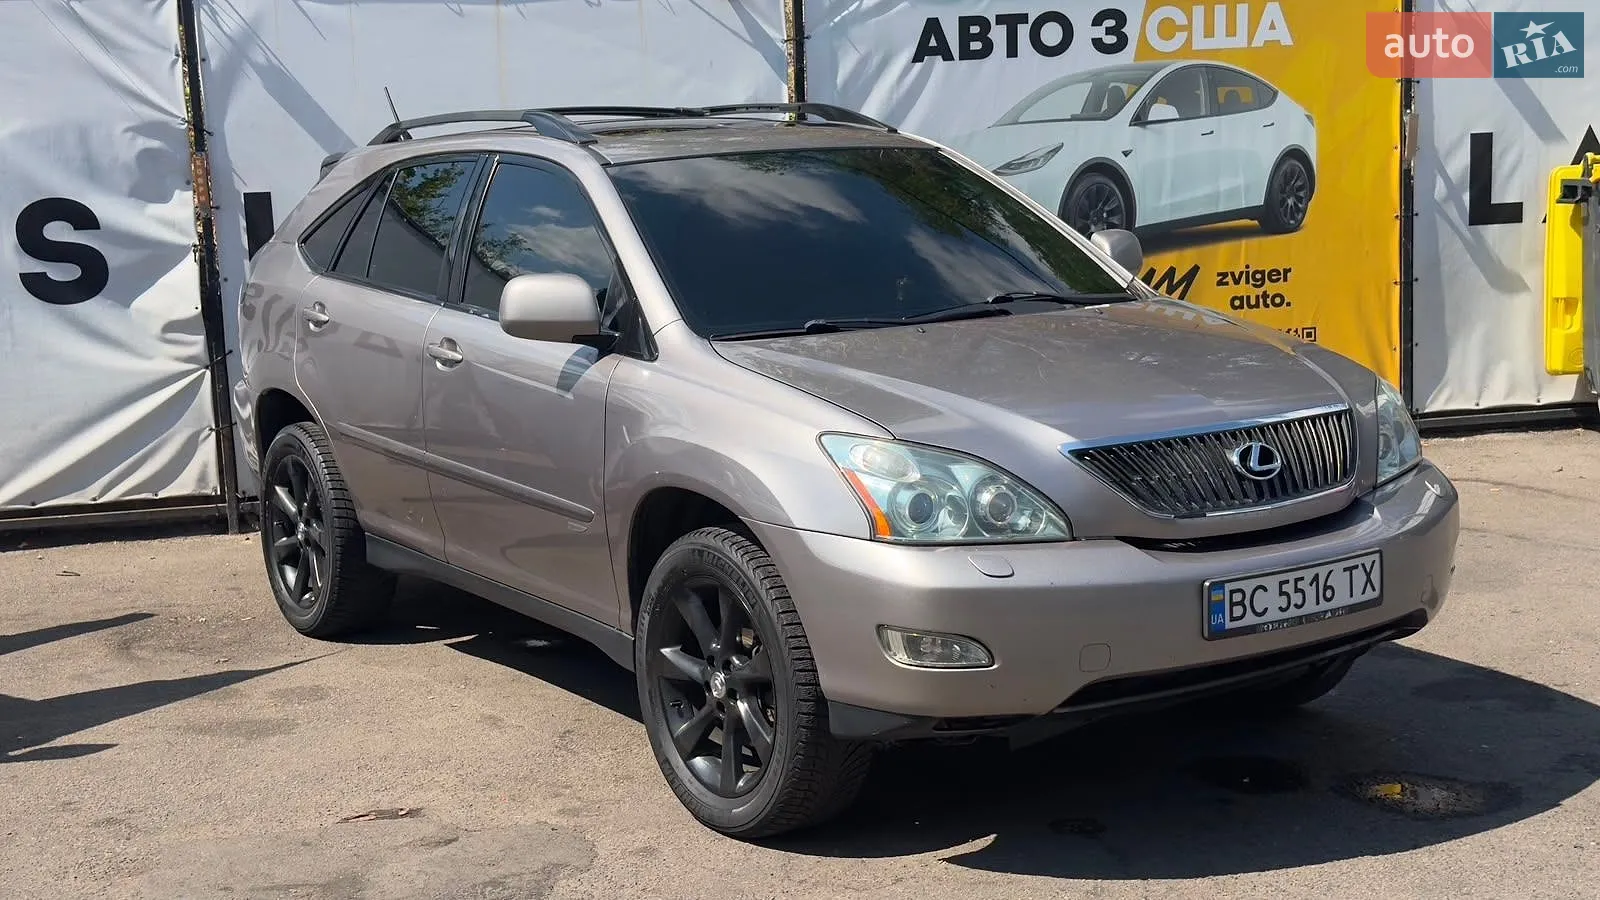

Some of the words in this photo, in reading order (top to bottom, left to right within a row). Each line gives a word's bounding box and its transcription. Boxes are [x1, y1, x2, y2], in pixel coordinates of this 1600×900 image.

[911, 10, 1074, 63] АВТО
[1145, 2, 1294, 52] США
[15, 197, 109, 305] S
[1216, 264, 1292, 289] zviger
[1229, 291, 1291, 310] auto.
[1228, 584, 1268, 622] BC
[1278, 569, 1336, 613] 5516
[1343, 559, 1377, 598] TX
[1211, 613, 1225, 625] UA
